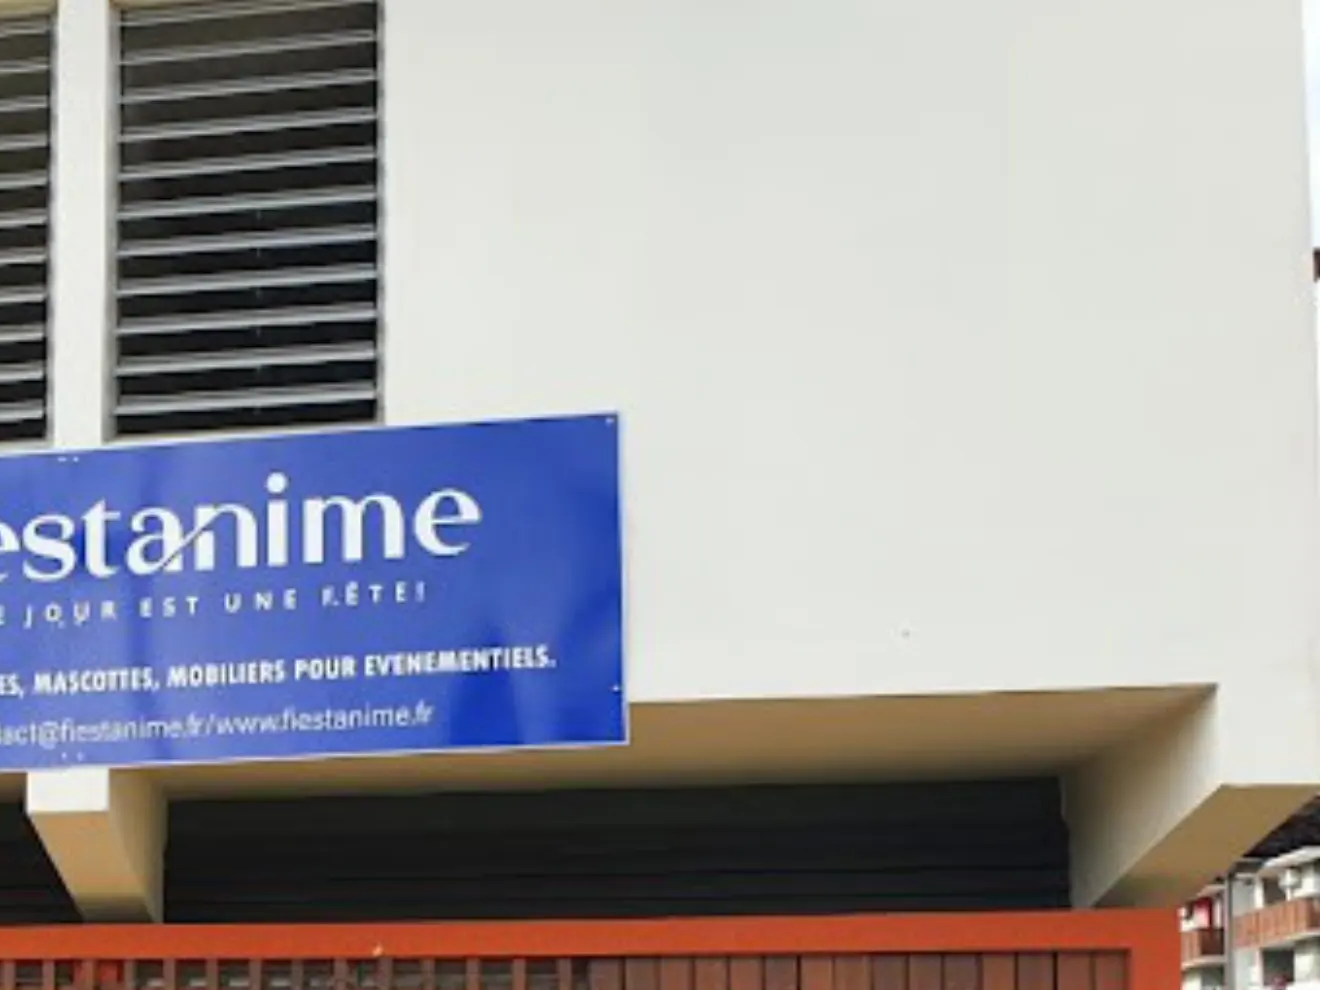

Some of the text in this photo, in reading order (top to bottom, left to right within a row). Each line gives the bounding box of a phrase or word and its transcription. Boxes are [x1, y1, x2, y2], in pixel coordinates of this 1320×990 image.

[22, 599, 118, 630] JOUR
[139, 596, 200, 619] EST
[224, 587, 298, 615] UNE
[32, 666, 162, 696] MASCOTTES,
[165, 658, 286, 689] MOBILIERS
[293, 653, 357, 682] POUR
[363, 643, 558, 678] EVENEMENTIELS.
